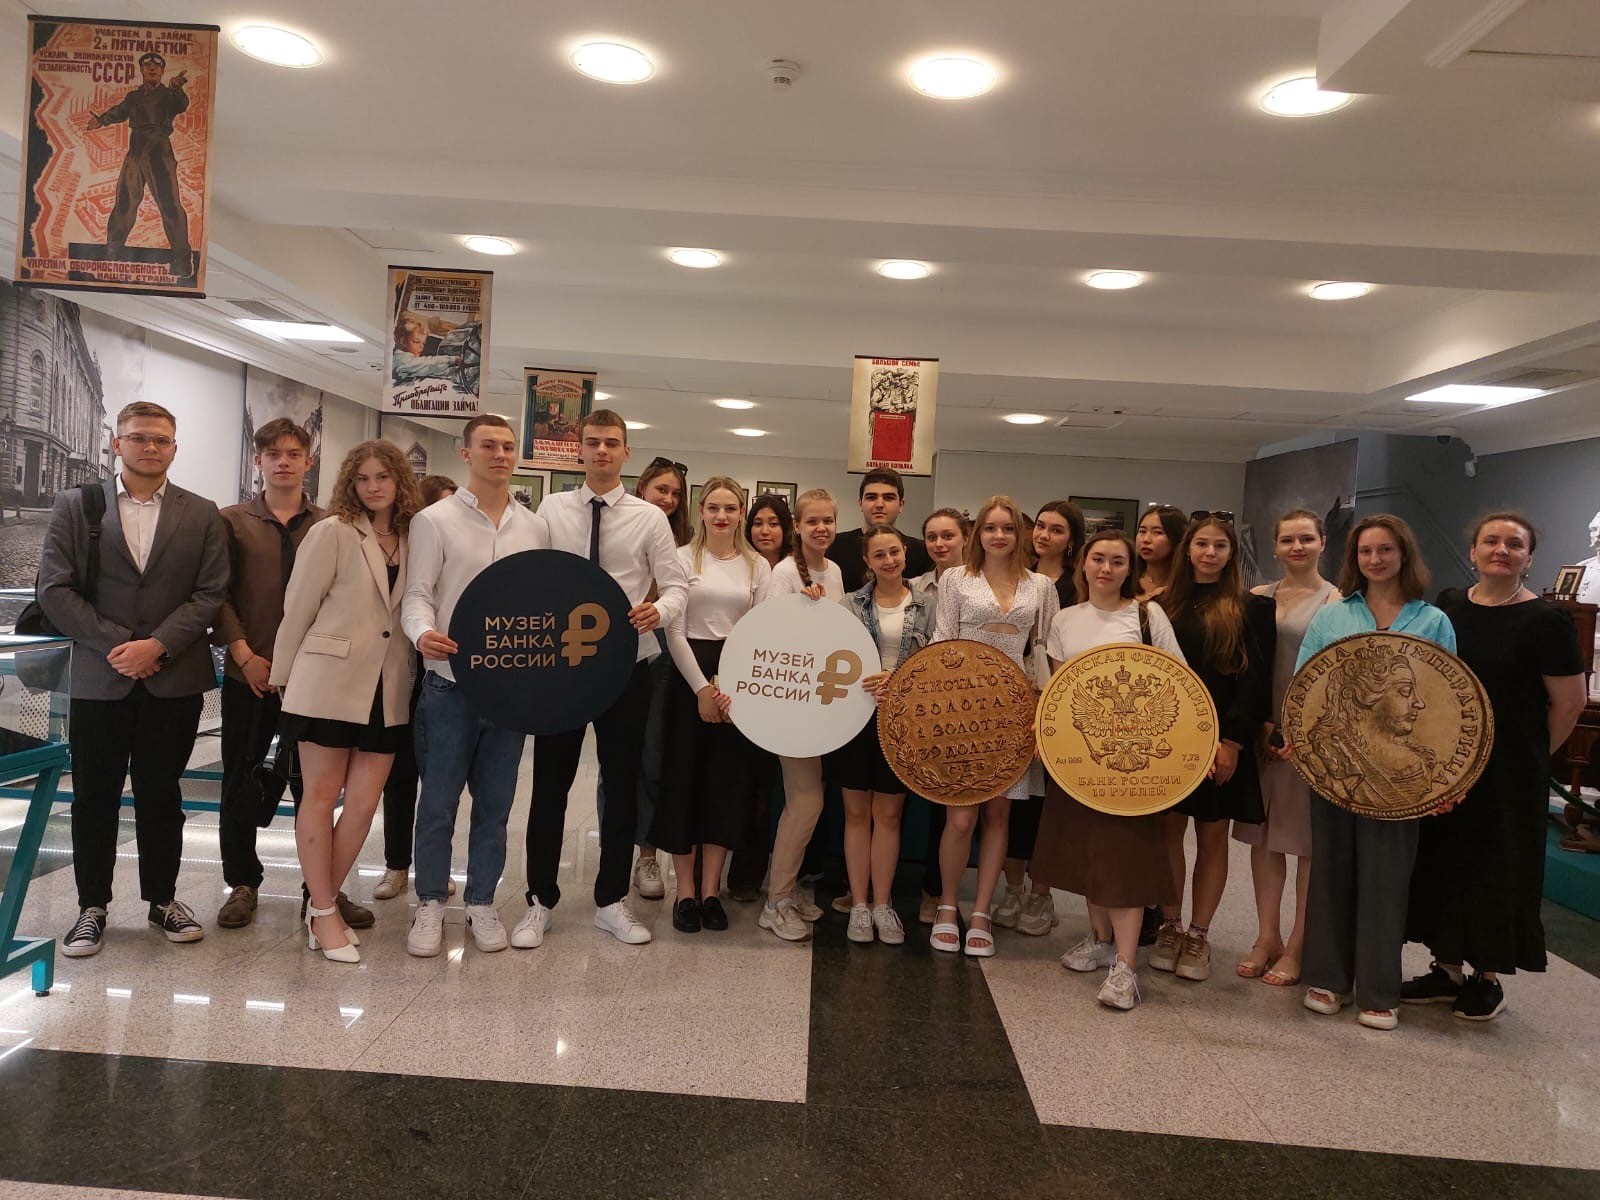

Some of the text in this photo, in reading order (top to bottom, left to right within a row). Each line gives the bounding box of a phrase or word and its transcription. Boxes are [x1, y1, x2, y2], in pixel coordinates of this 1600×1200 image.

[92, 61, 135, 84] СССР
[70, 260, 169, 275] ОБОРОНОСПОСОБНОСТЬ
[136, 274, 175, 283] СТРАНЫ
[485, 612, 556, 631] МУЗЕЙ
[485, 634, 555, 649] БАНКА
[470, 653, 556, 669] РОССИИ
[753, 648, 815, 669] МУЗЕЙ
[751, 665, 811, 685] БАНКА
[736, 680, 811, 702] РОССИИ
[1045, 651, 1210, 722] РОССИЙСКАЯ ФЕДЕРАЦИЯ
[915, 696, 1005, 716] ЗОЛОТА
[1078, 775, 1182, 786] БАНК РОССИИ
[1091, 785, 1167, 797] 10 РУБЛЕЙ
